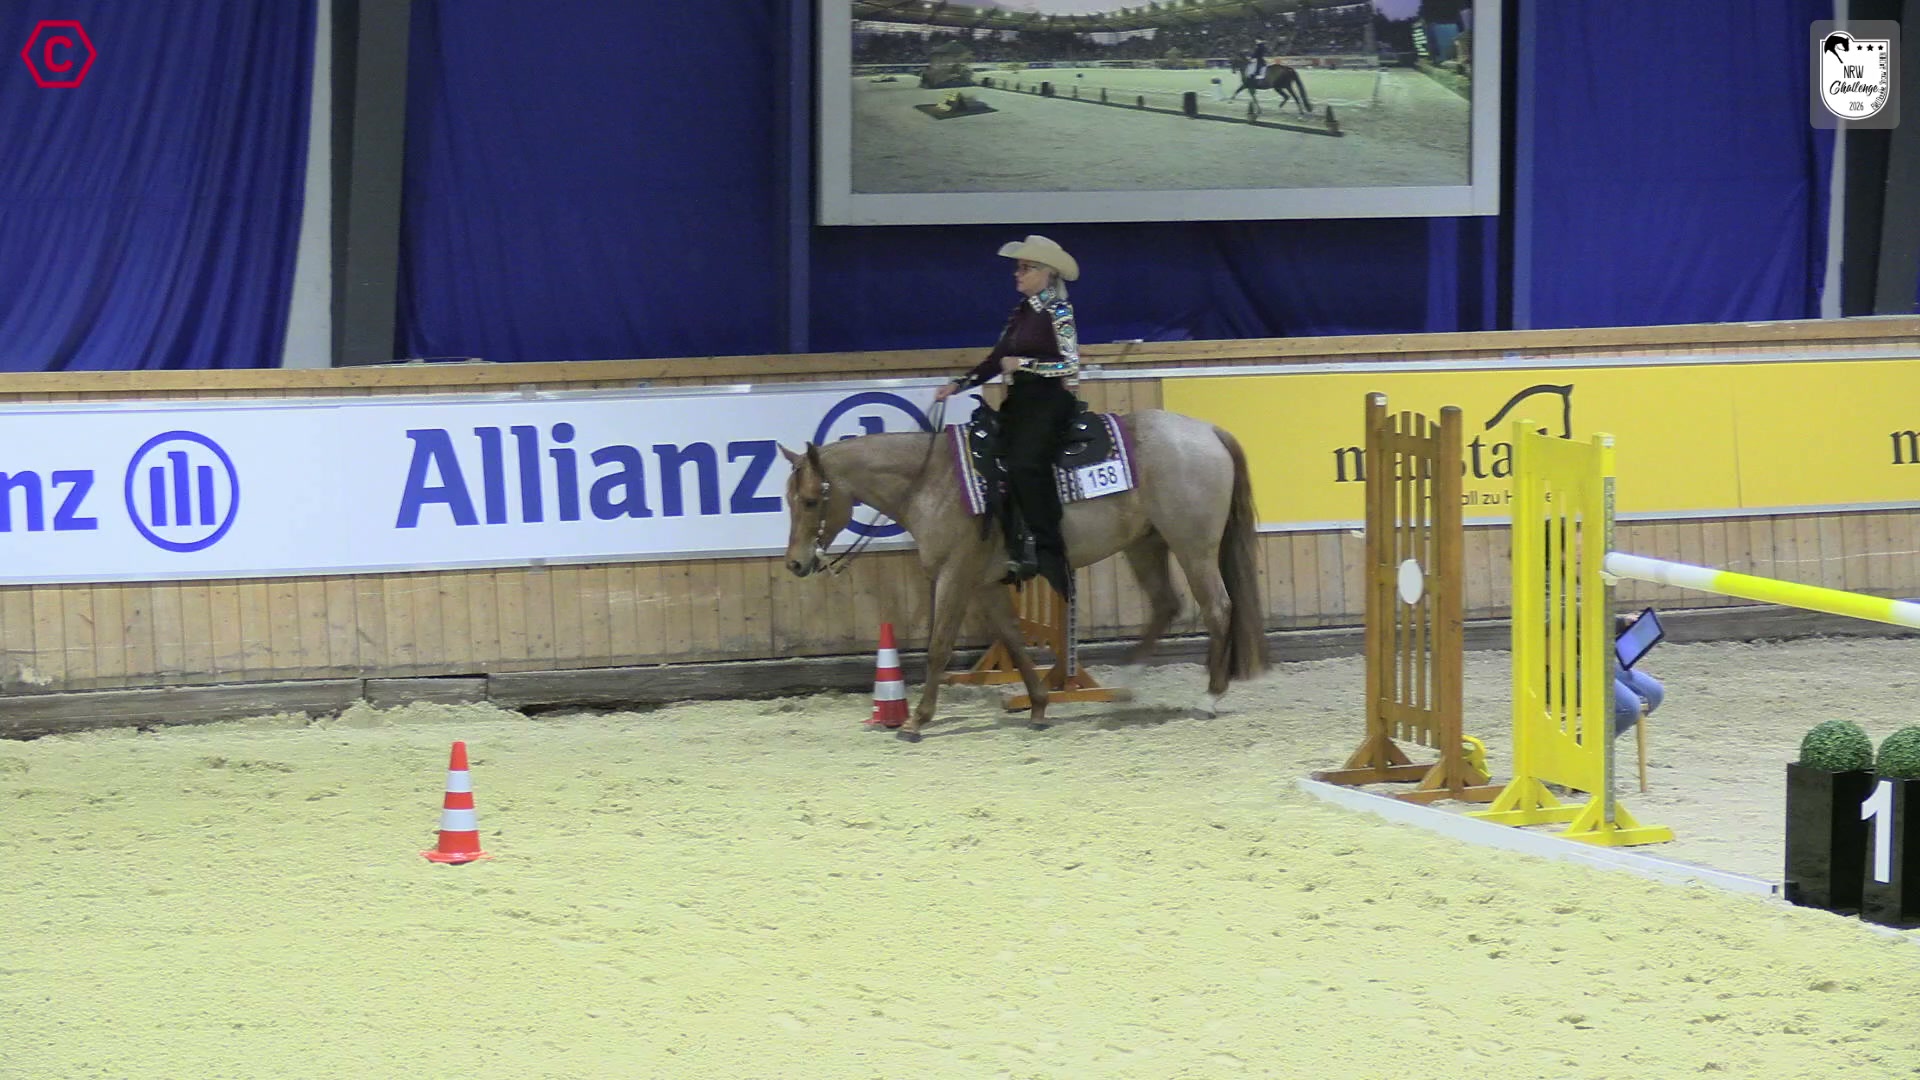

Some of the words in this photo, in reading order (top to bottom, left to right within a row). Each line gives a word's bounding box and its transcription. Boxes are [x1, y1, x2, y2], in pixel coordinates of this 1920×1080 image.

[396, 422, 781, 529] Allianz
[1088, 465, 1118, 488] 158
[1482, 493, 1500, 504] zu
[1860, 780, 1892, 883] 1
